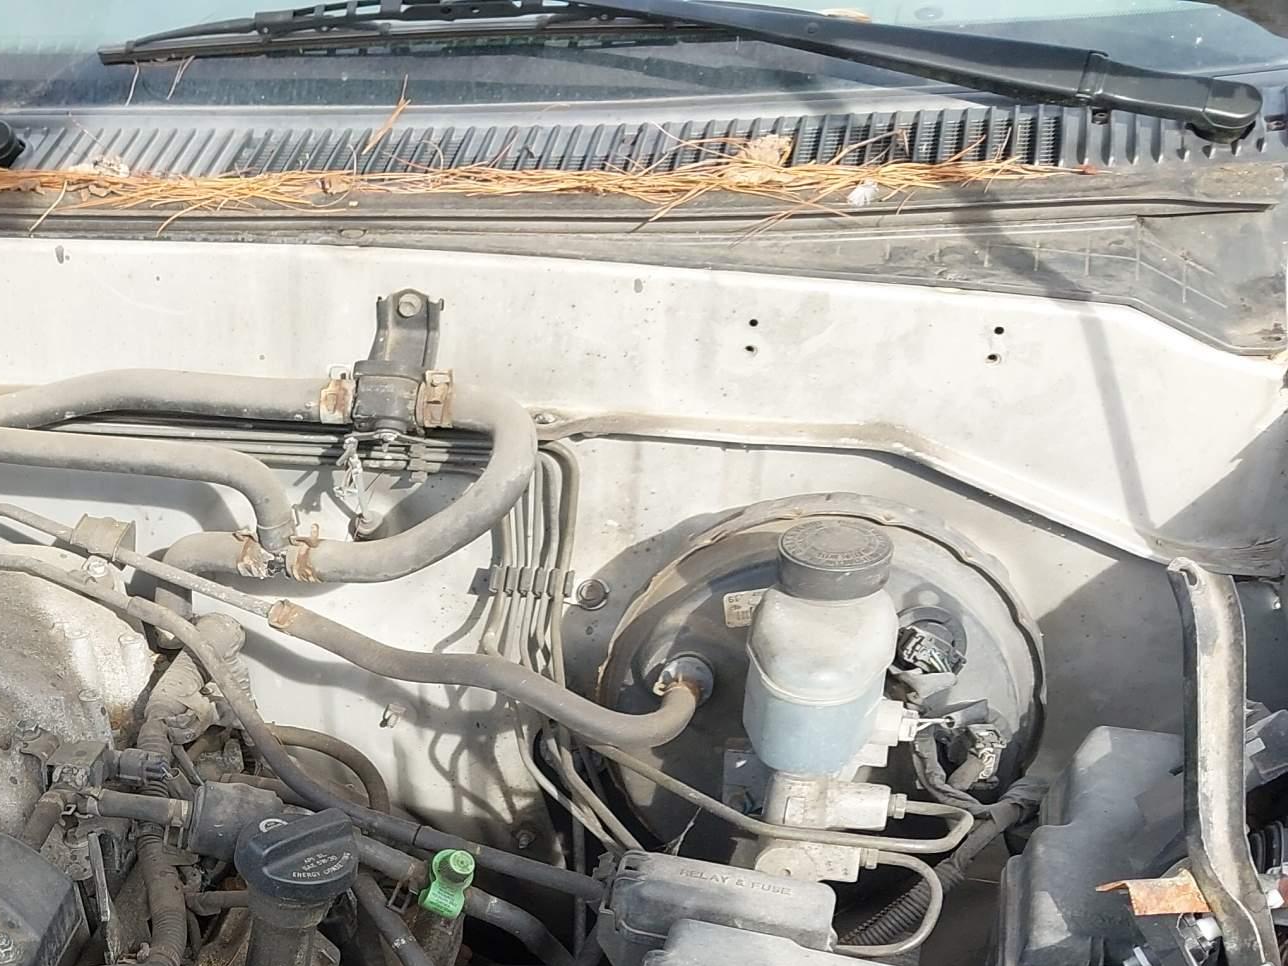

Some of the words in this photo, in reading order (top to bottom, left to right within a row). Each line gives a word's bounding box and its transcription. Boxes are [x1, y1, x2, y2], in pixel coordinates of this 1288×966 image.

[292, 871, 321, 879] ENERGY
[679, 868, 730, 884] RELAY
[735, 879, 745, 888] &
[751, 881, 793, 896] FUSE
